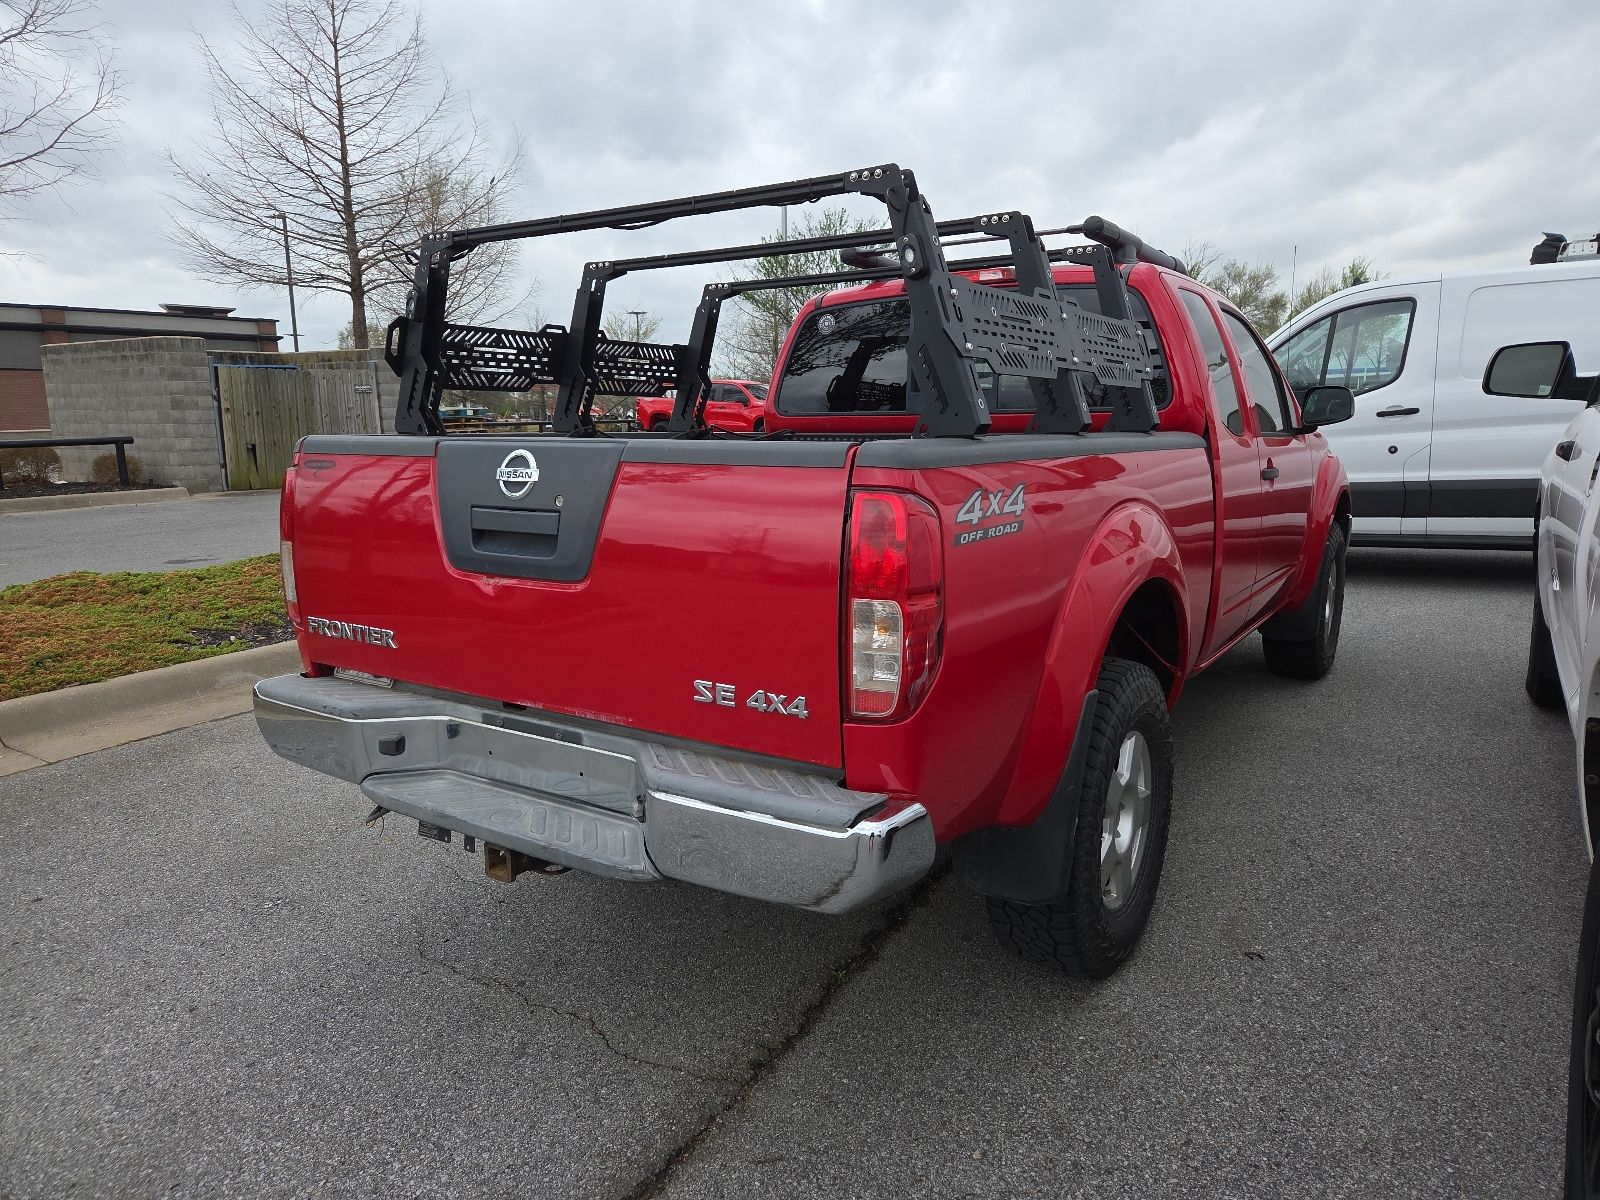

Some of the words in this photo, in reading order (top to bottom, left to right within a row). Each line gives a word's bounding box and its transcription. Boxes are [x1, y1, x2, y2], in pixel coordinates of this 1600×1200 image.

[498, 470, 533, 479] NISSAN
[960, 530, 984, 544] OFF
[987, 522, 1019, 538] ROAD
[307, 616, 399, 649] FRONTIER
[693, 679, 736, 707] SE
